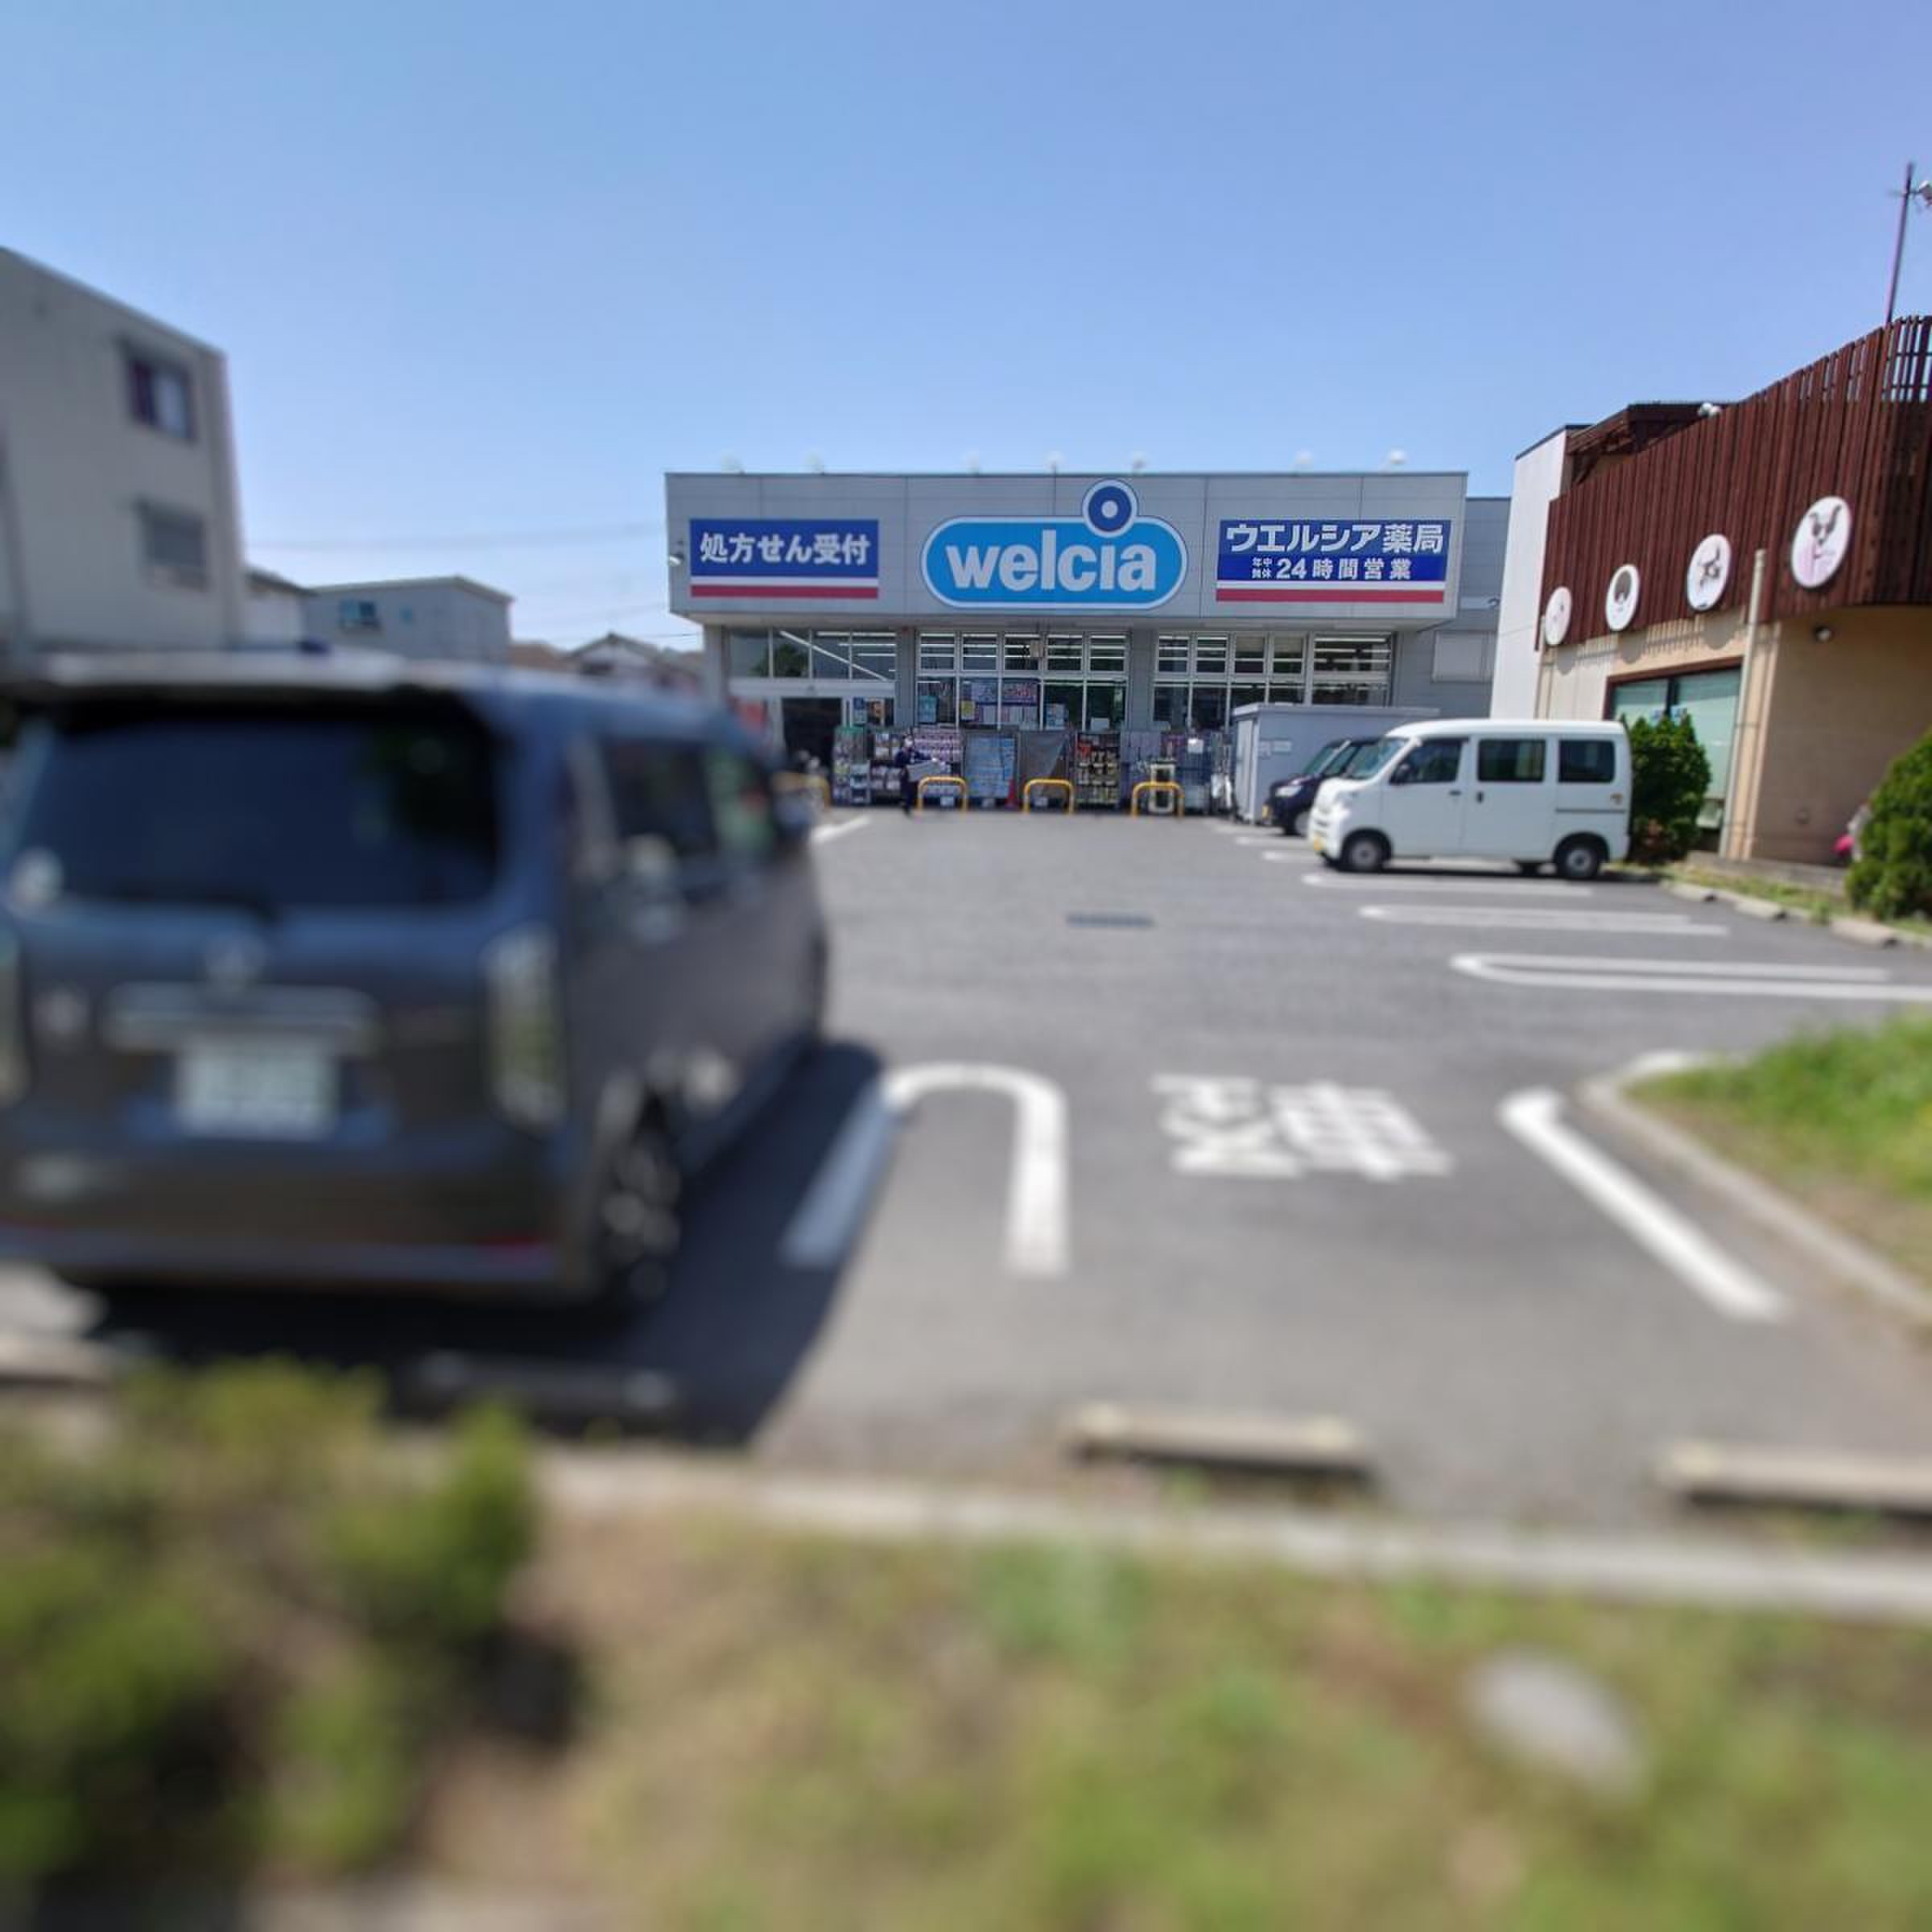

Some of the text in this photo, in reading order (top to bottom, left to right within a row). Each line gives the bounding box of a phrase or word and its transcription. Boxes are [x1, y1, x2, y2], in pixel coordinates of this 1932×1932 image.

[700, 532, 870, 565] 処方せん受付
[1226, 524, 1443, 552] ウエルシア薬局
[945, 528, 1157, 592] welcia
[1276, 557, 1412, 580] 24時間営業
